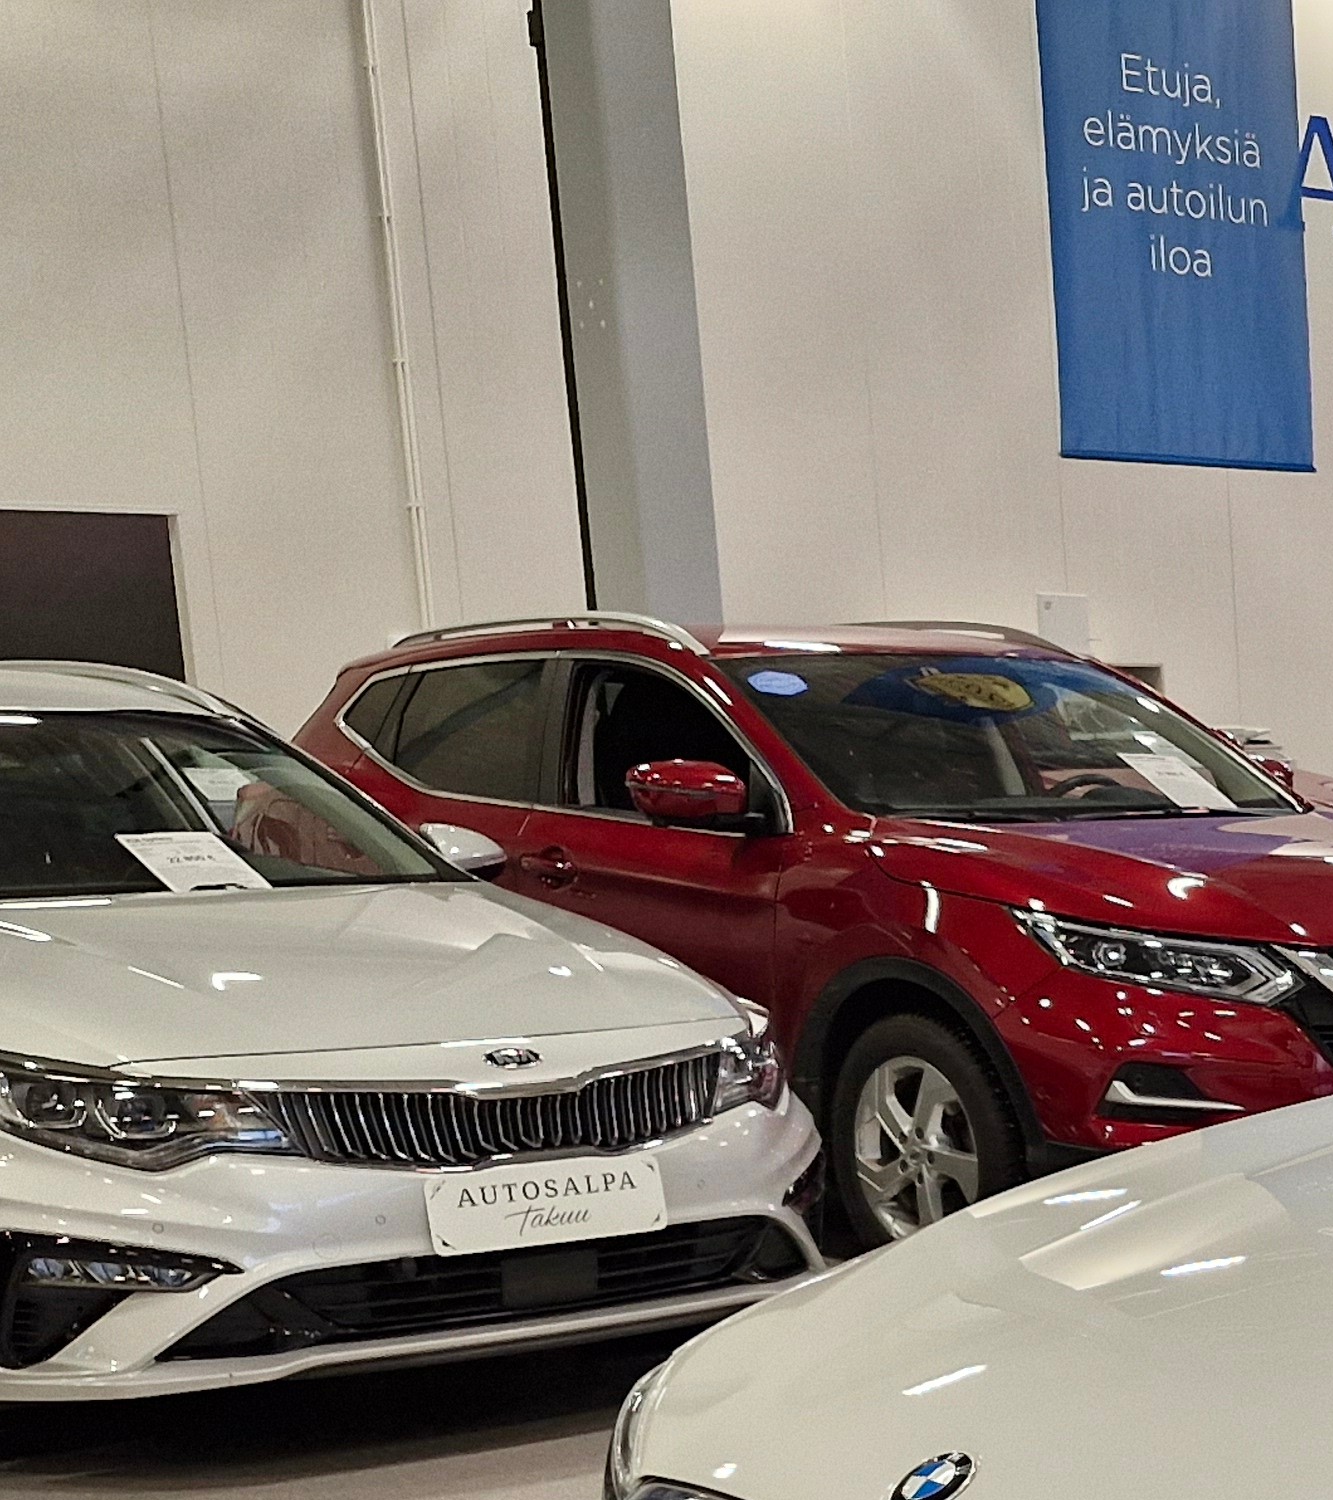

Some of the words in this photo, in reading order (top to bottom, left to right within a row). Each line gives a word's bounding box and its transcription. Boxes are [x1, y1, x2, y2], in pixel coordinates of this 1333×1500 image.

[1120, 53, 1221, 109] Etuja,
[1082, 109, 1262, 169] elämyksiä
[1081, 166, 1114, 213] ja
[1126, 179, 1269, 227] autoilun
[1149, 234, 1213, 278] iloa
[457, 1170, 637, 1209] AUTOSALPA
[504, 1204, 593, 1237] Takuu
